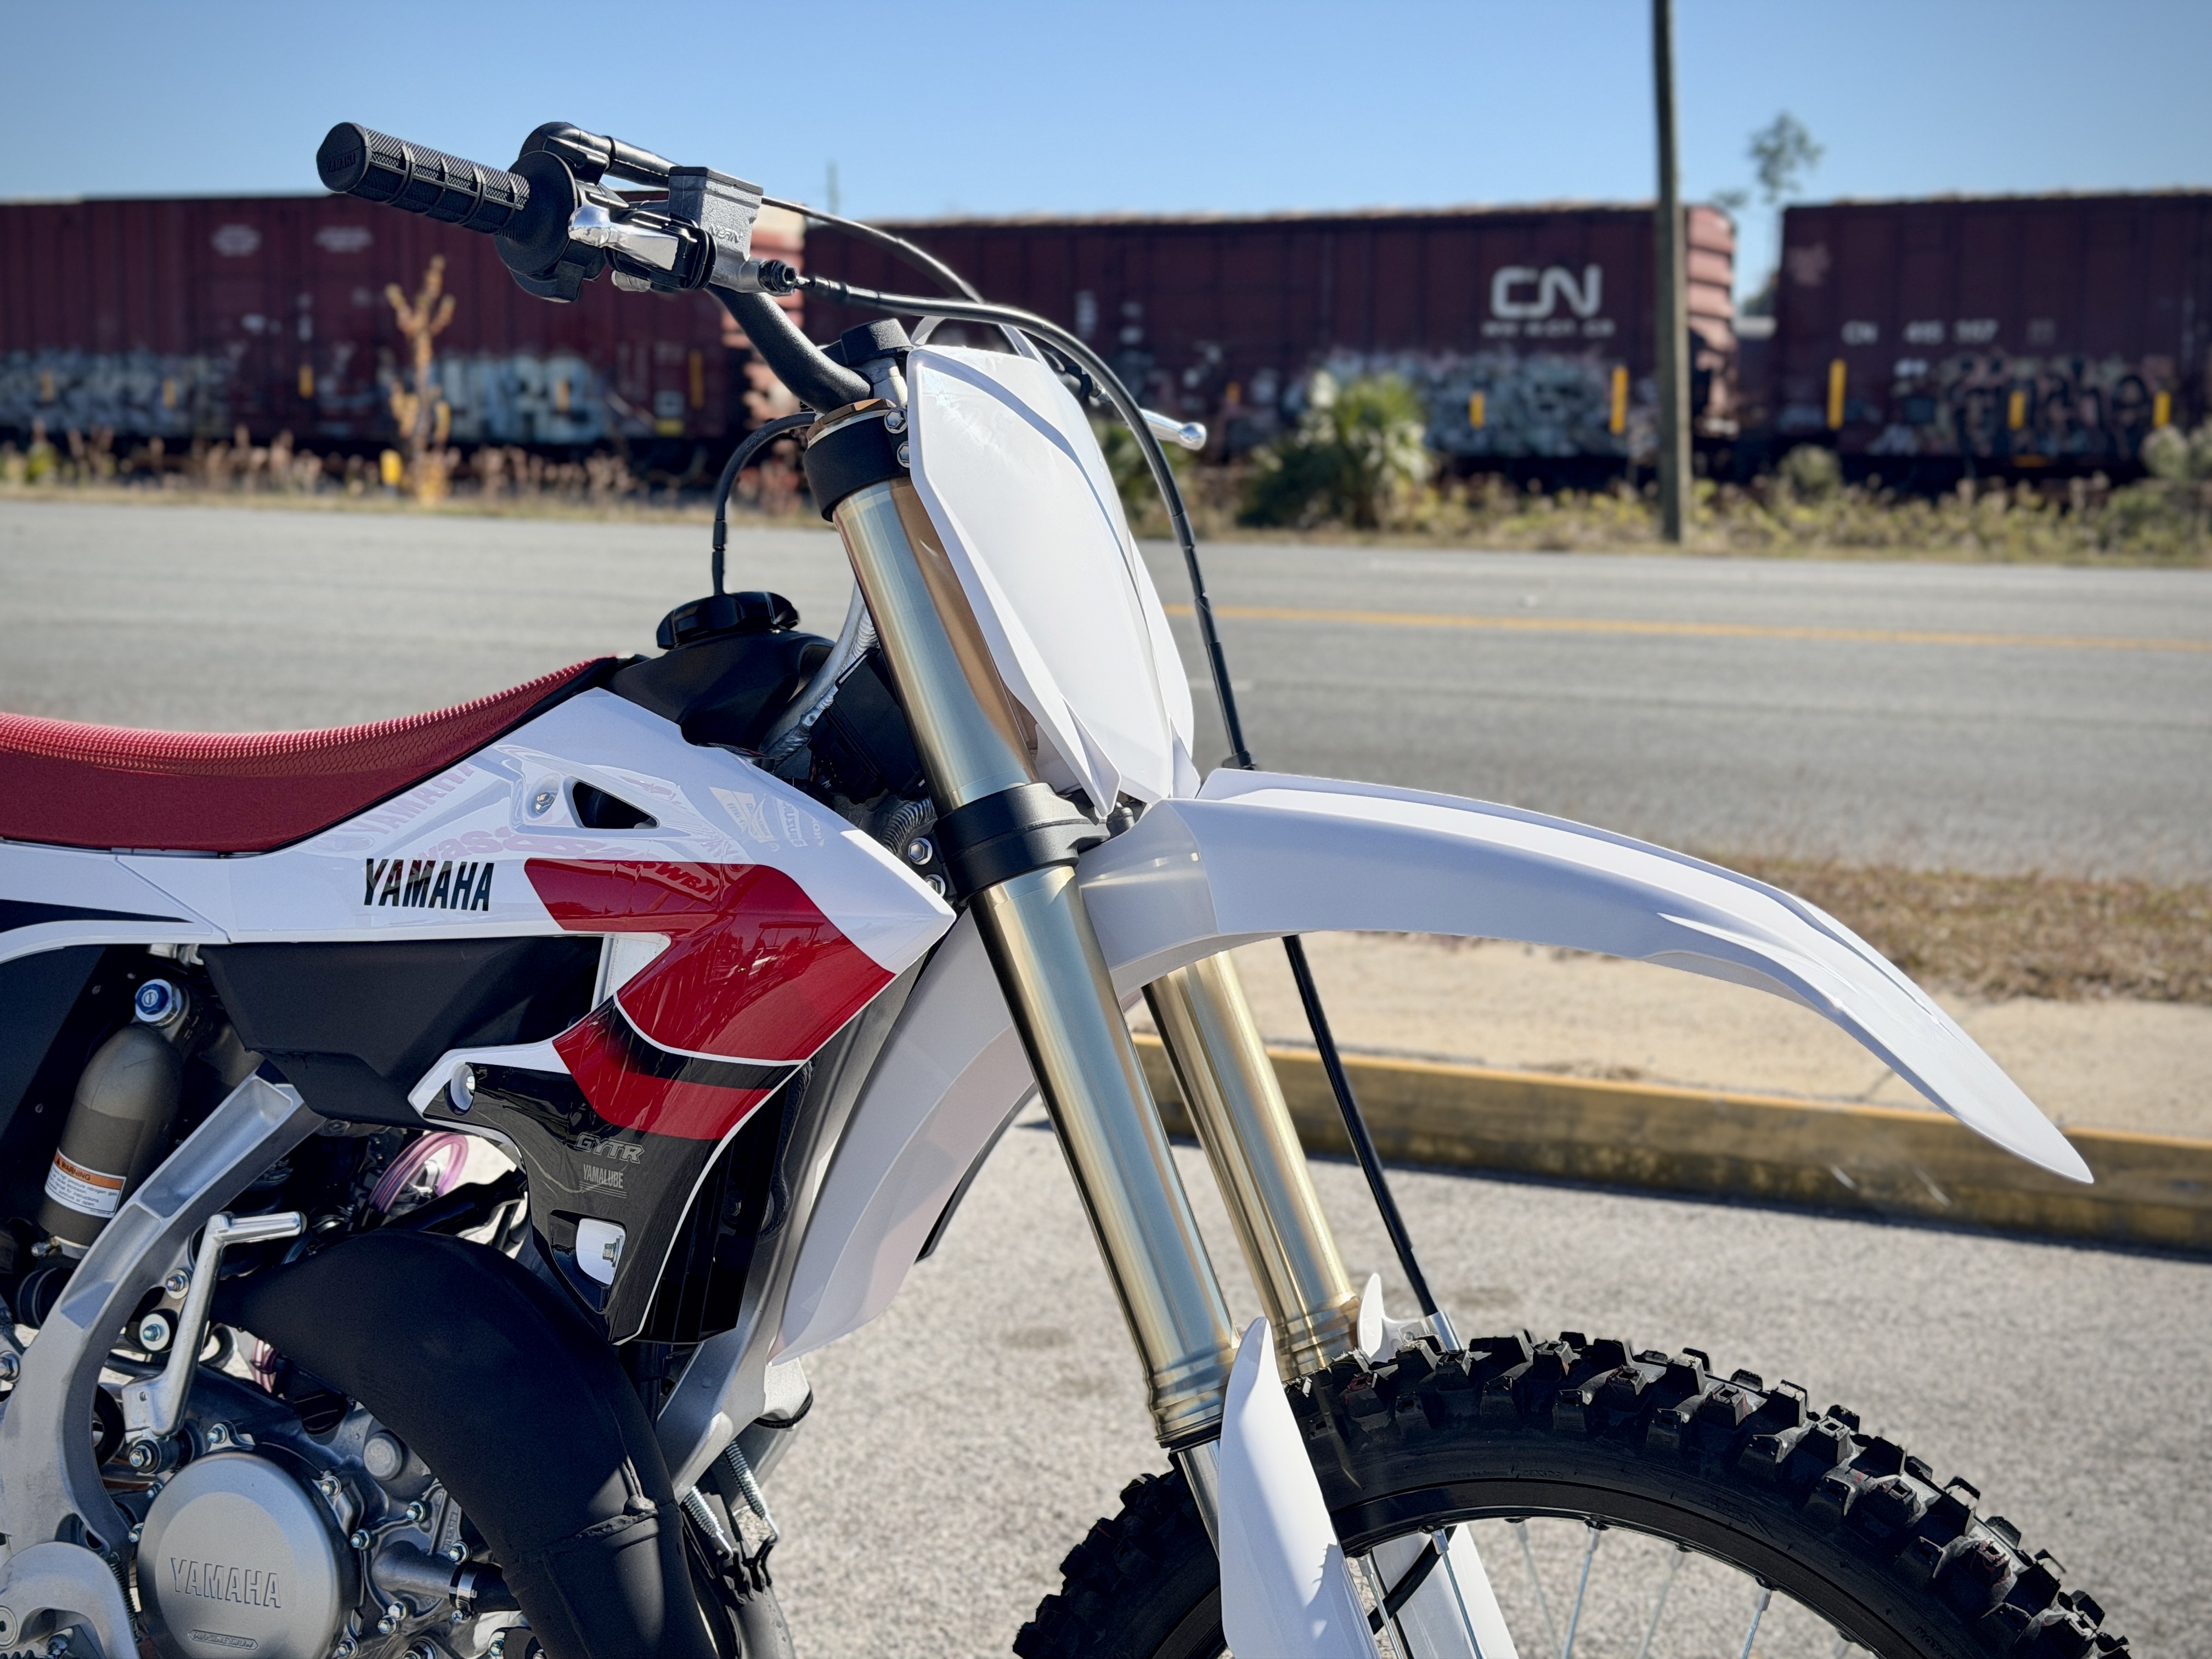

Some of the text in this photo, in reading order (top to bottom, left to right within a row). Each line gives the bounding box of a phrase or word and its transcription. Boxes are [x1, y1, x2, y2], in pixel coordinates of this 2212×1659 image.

[1491, 264, 1602, 318] CN
[364, 858, 495, 911] YAMAHA
[574, 1132, 645, 1164] GYTR
[61, 1161, 91, 1181] WARNING
[583, 1163, 624, 1189] YAMALUBE
[170, 1556, 281, 1609] YAMAHA
